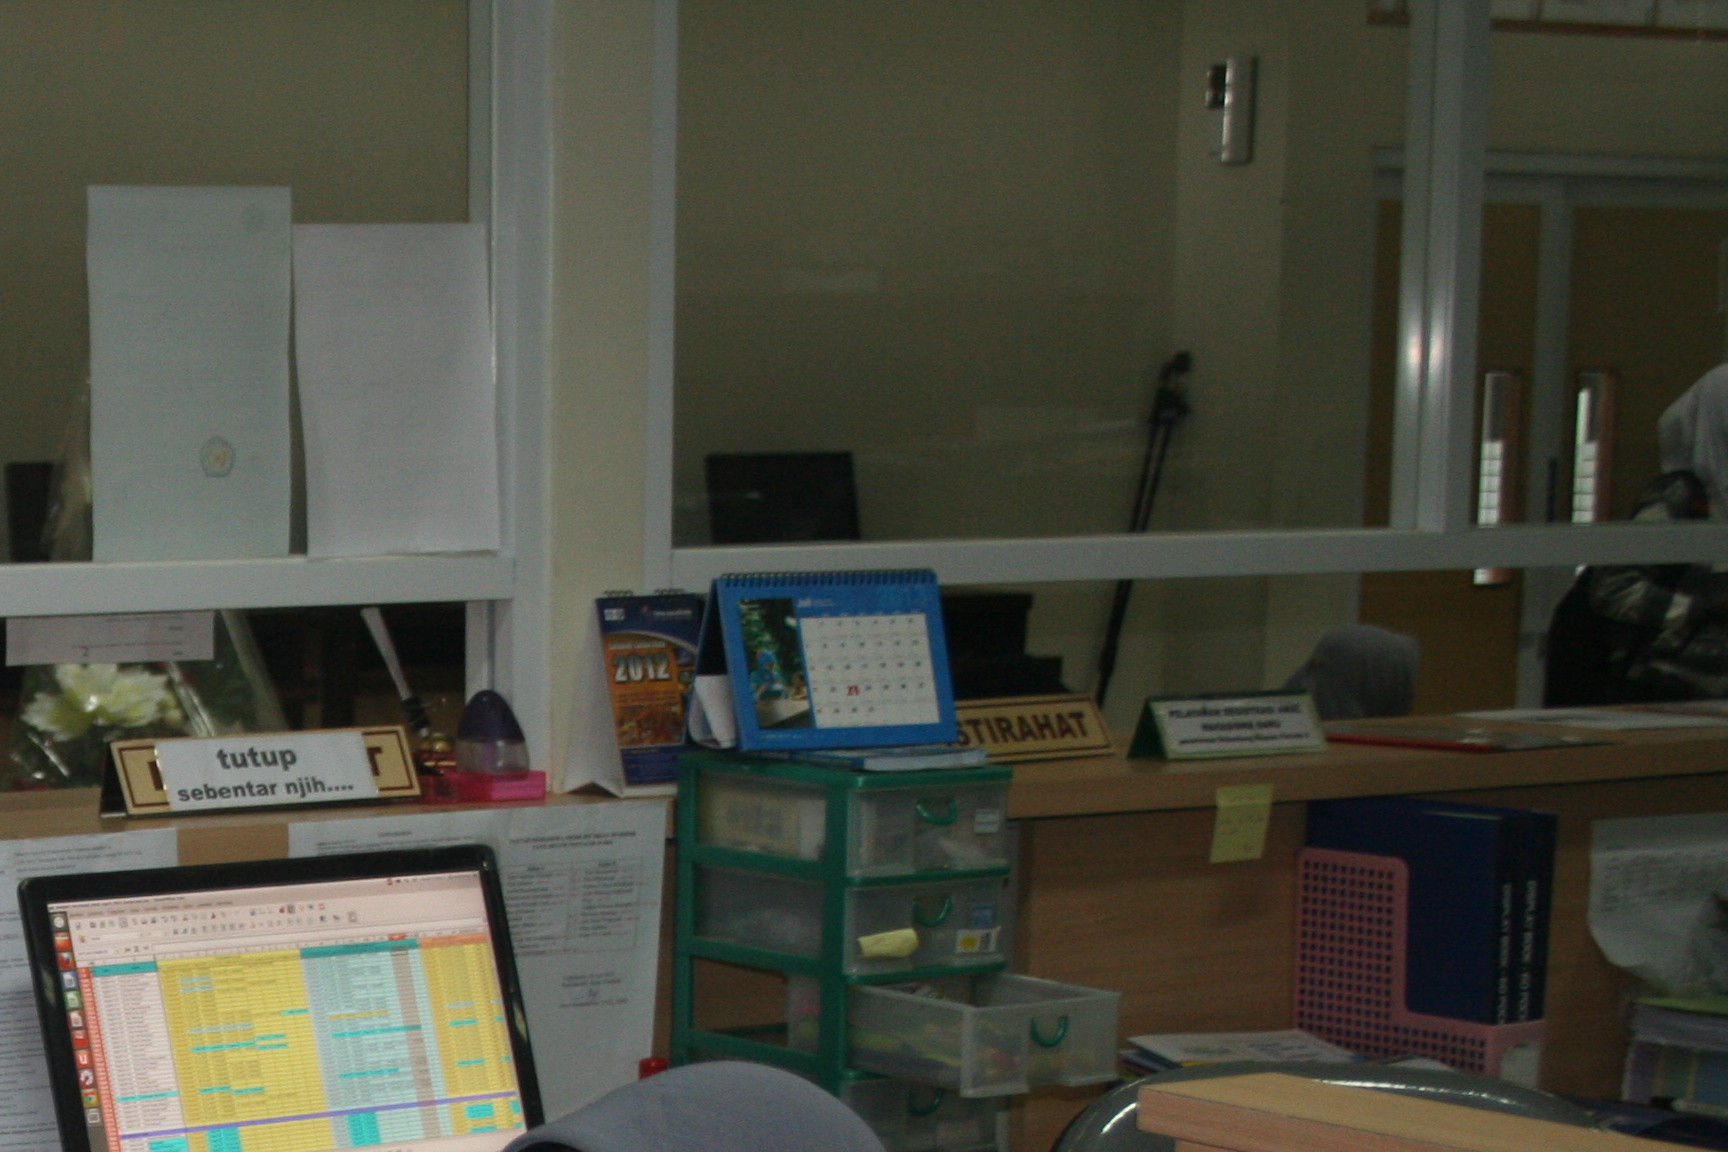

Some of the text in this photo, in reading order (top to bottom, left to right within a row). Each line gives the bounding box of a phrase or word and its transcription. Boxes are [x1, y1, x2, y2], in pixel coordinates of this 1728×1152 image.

[613, 653, 671, 683] 2012
[948, 711, 1087, 747] STIRAHAT
[217, 748, 297, 771] tutup
[177, 781, 277, 802] sebentar
